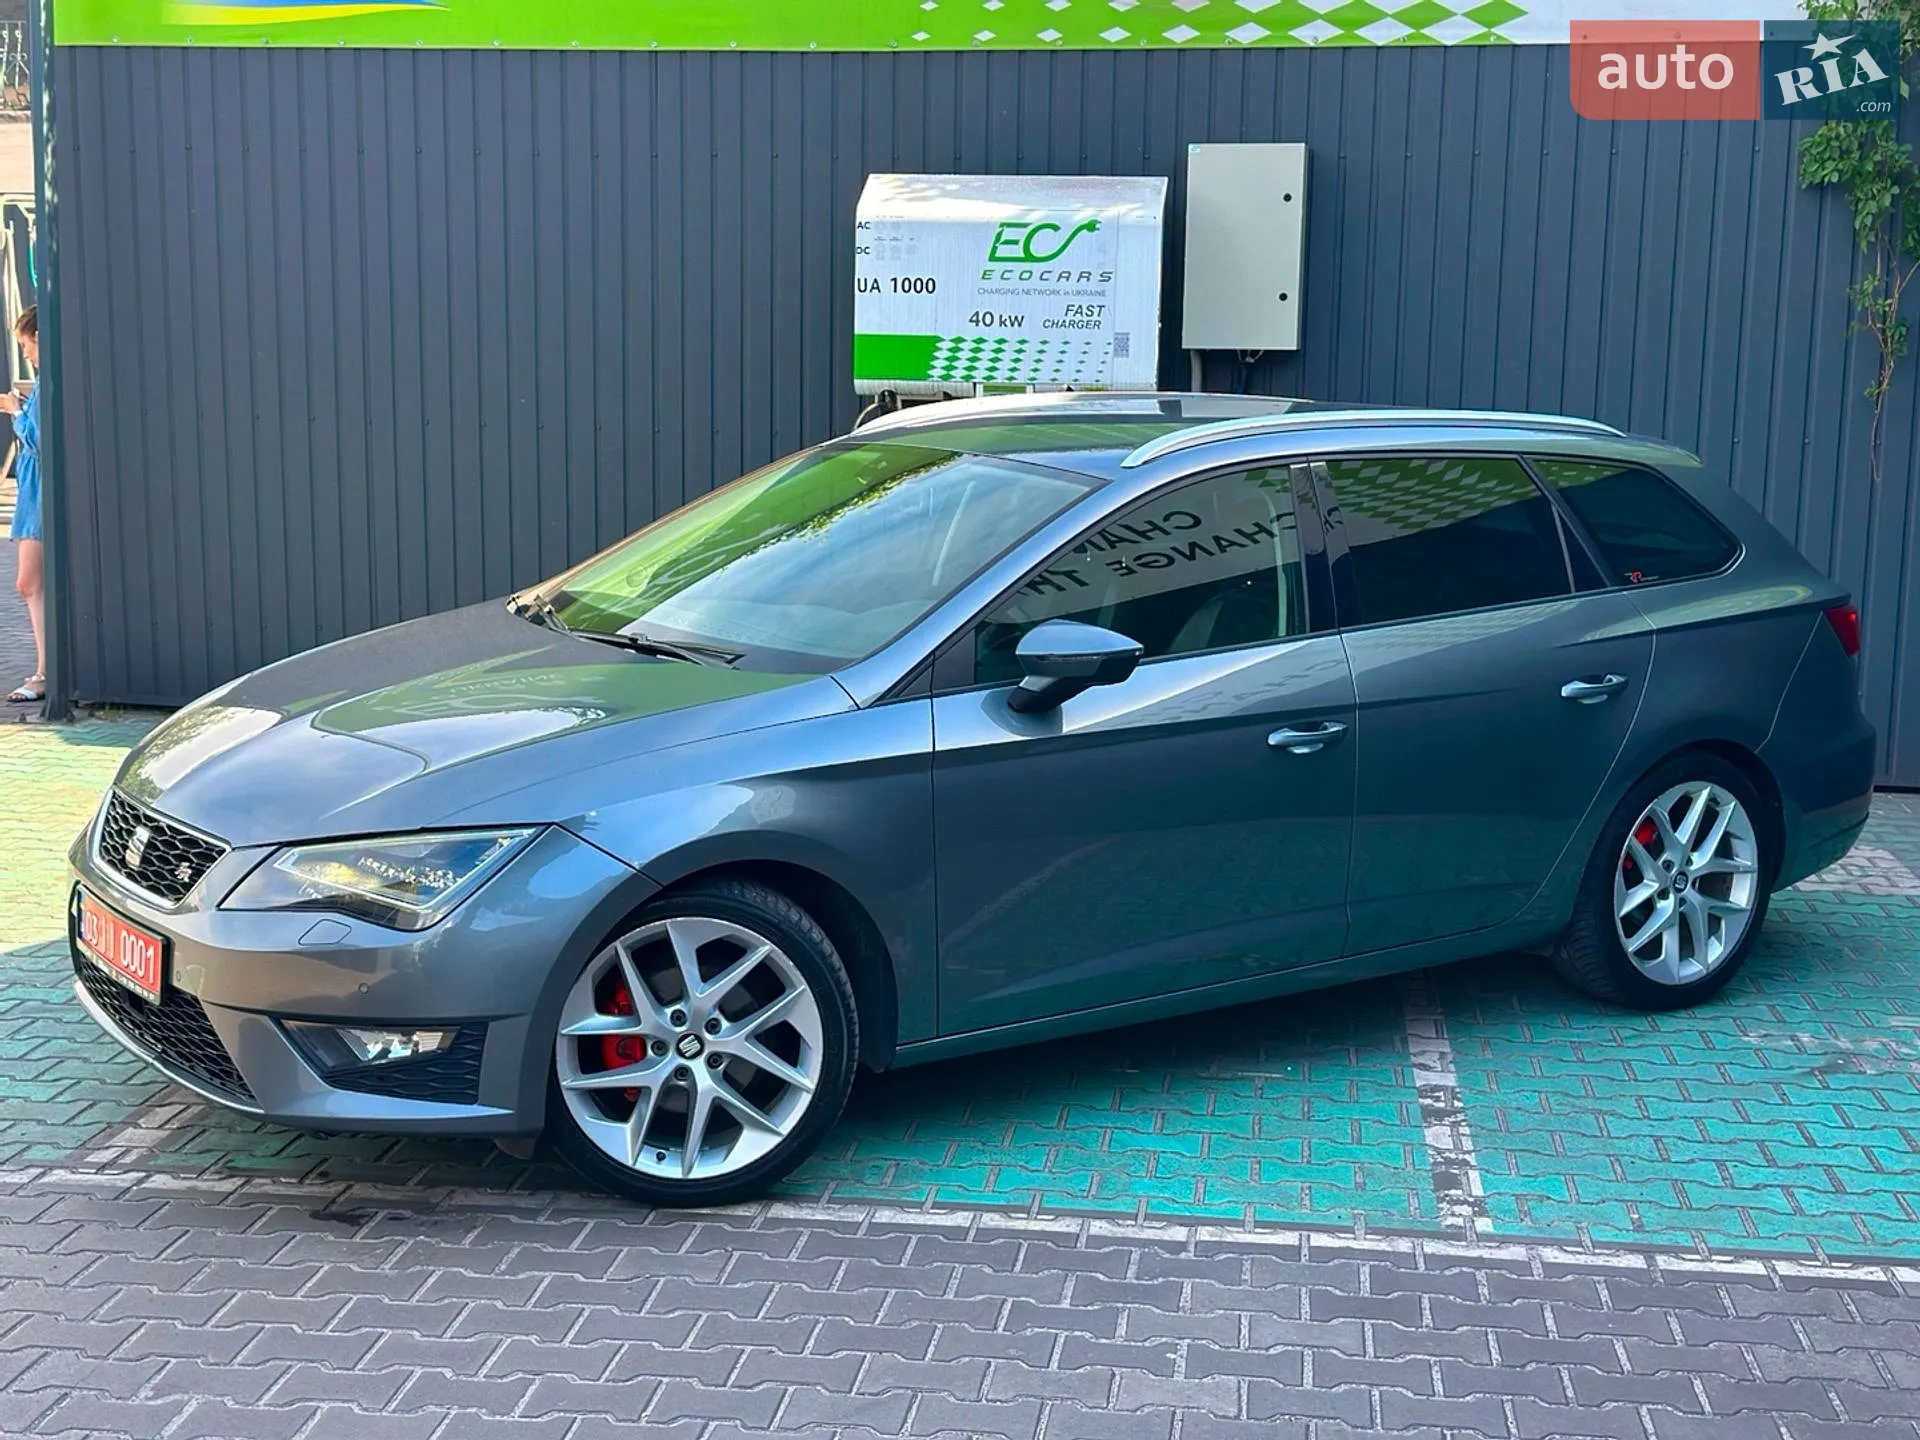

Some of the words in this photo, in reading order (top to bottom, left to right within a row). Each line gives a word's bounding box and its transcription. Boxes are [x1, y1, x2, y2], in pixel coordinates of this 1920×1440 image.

[857, 221, 872, 230] AC
[980, 269, 1113, 283] ECOCARS
[857, 277, 881, 293] UA
[890, 277, 936, 294] 1000
[977, 288, 1020, 297] CHARGING
[1022, 288, 1062, 296] NETWORK
[1071, 288, 1106, 297] UKRAINE
[1065, 304, 1105, 317] FAST
[968, 311, 994, 328] 40
[999, 313, 1025, 328] kW
[1042, 319, 1102, 330] CHARGER
[120, 929, 155, 984] 0001
